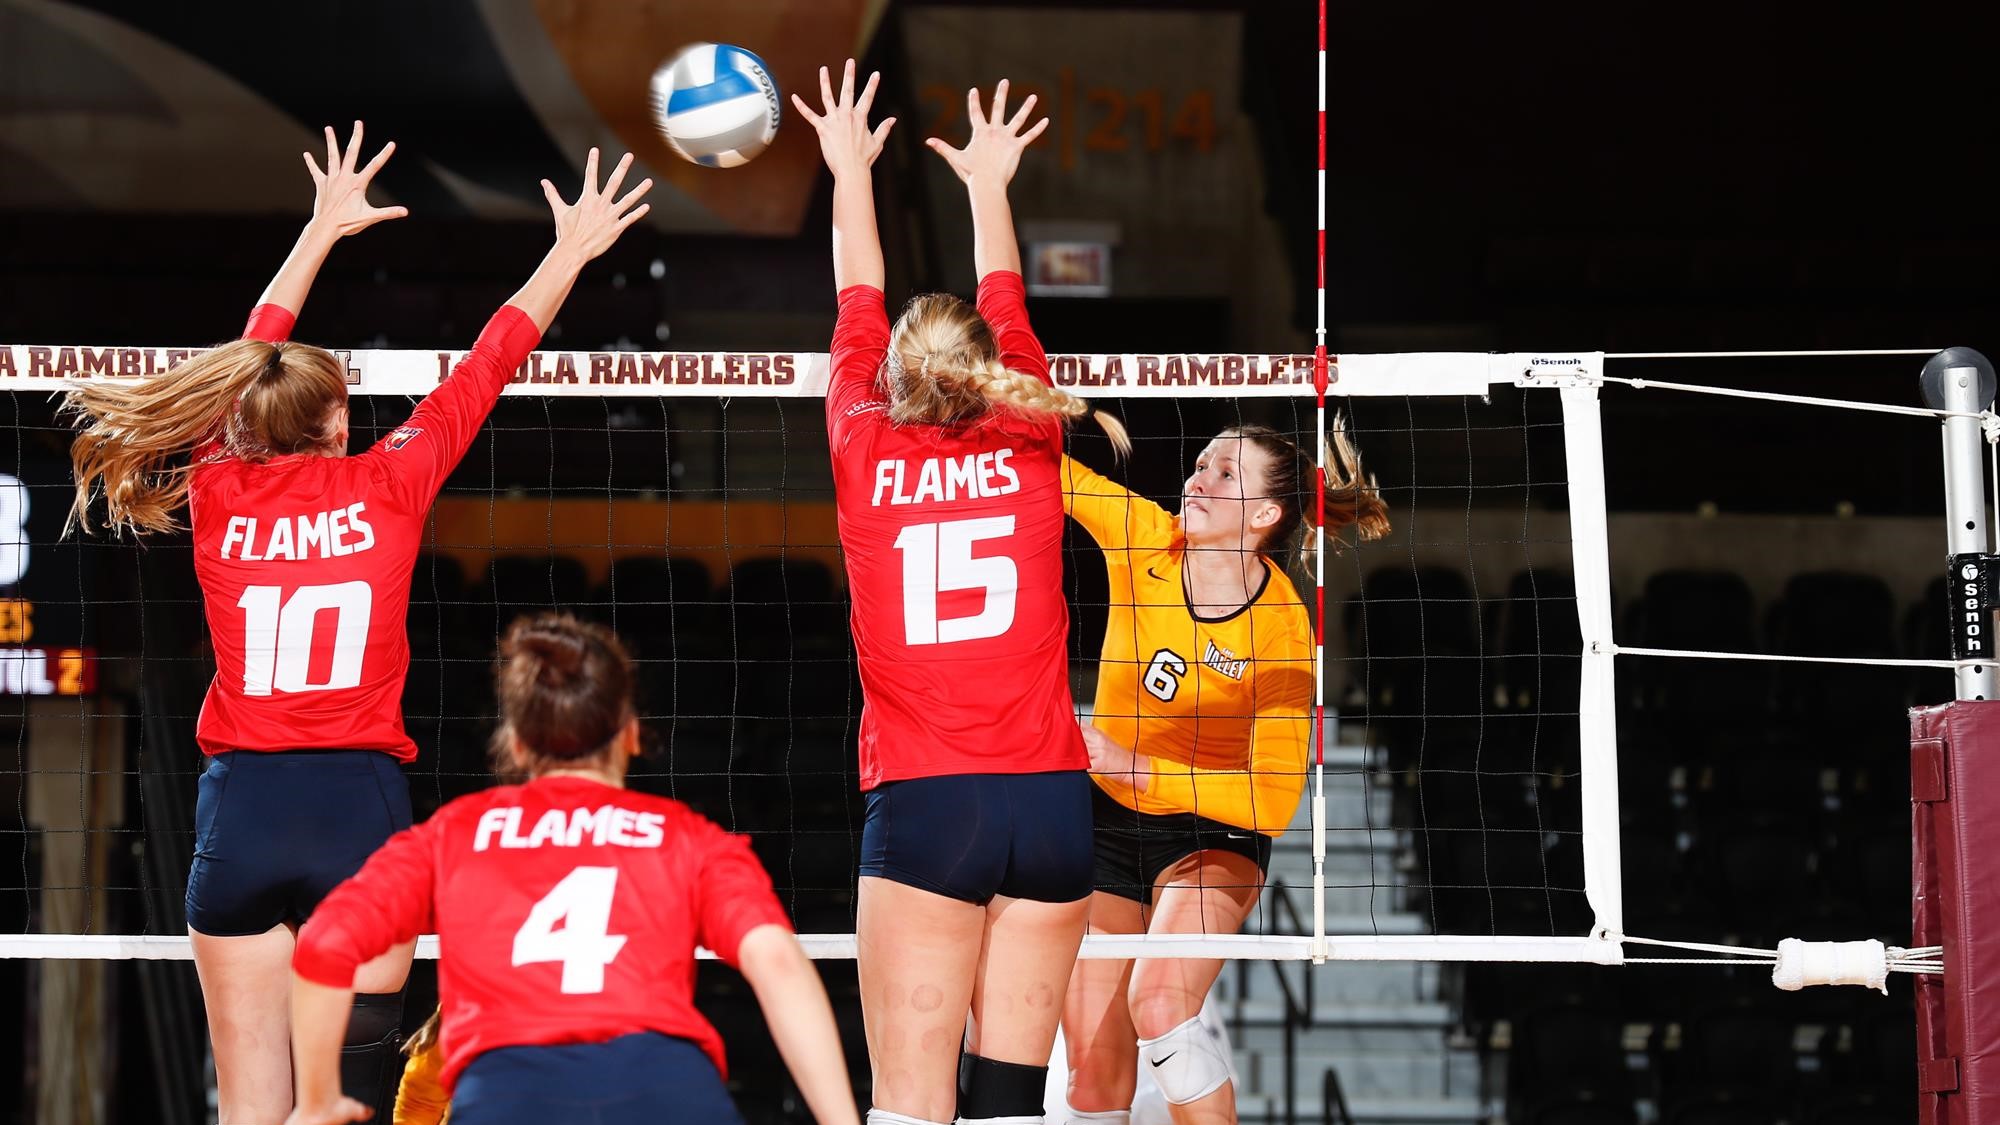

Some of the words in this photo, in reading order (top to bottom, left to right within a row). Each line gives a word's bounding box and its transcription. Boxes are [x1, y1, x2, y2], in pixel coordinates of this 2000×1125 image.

[28, 346, 205, 377] RAMBLE
[438, 352, 579, 384] LOLA
[589, 353, 796, 385] RAMBLERS
[1047, 355, 1126, 386] OLA
[1540, 358, 1582, 366] Senoh
[871, 448, 1021, 507] FLAMES
[220, 501, 375, 561] FLAMES
[893, 514, 1018, 646] 15
[236, 580, 373, 696] 10
[1203, 639, 1251, 681] VALLEY
[58, 649, 84, 695] 2
[1142, 648, 1187, 702] 6
[473, 804, 666, 852] FLAMES
[511, 866, 628, 994] 4
